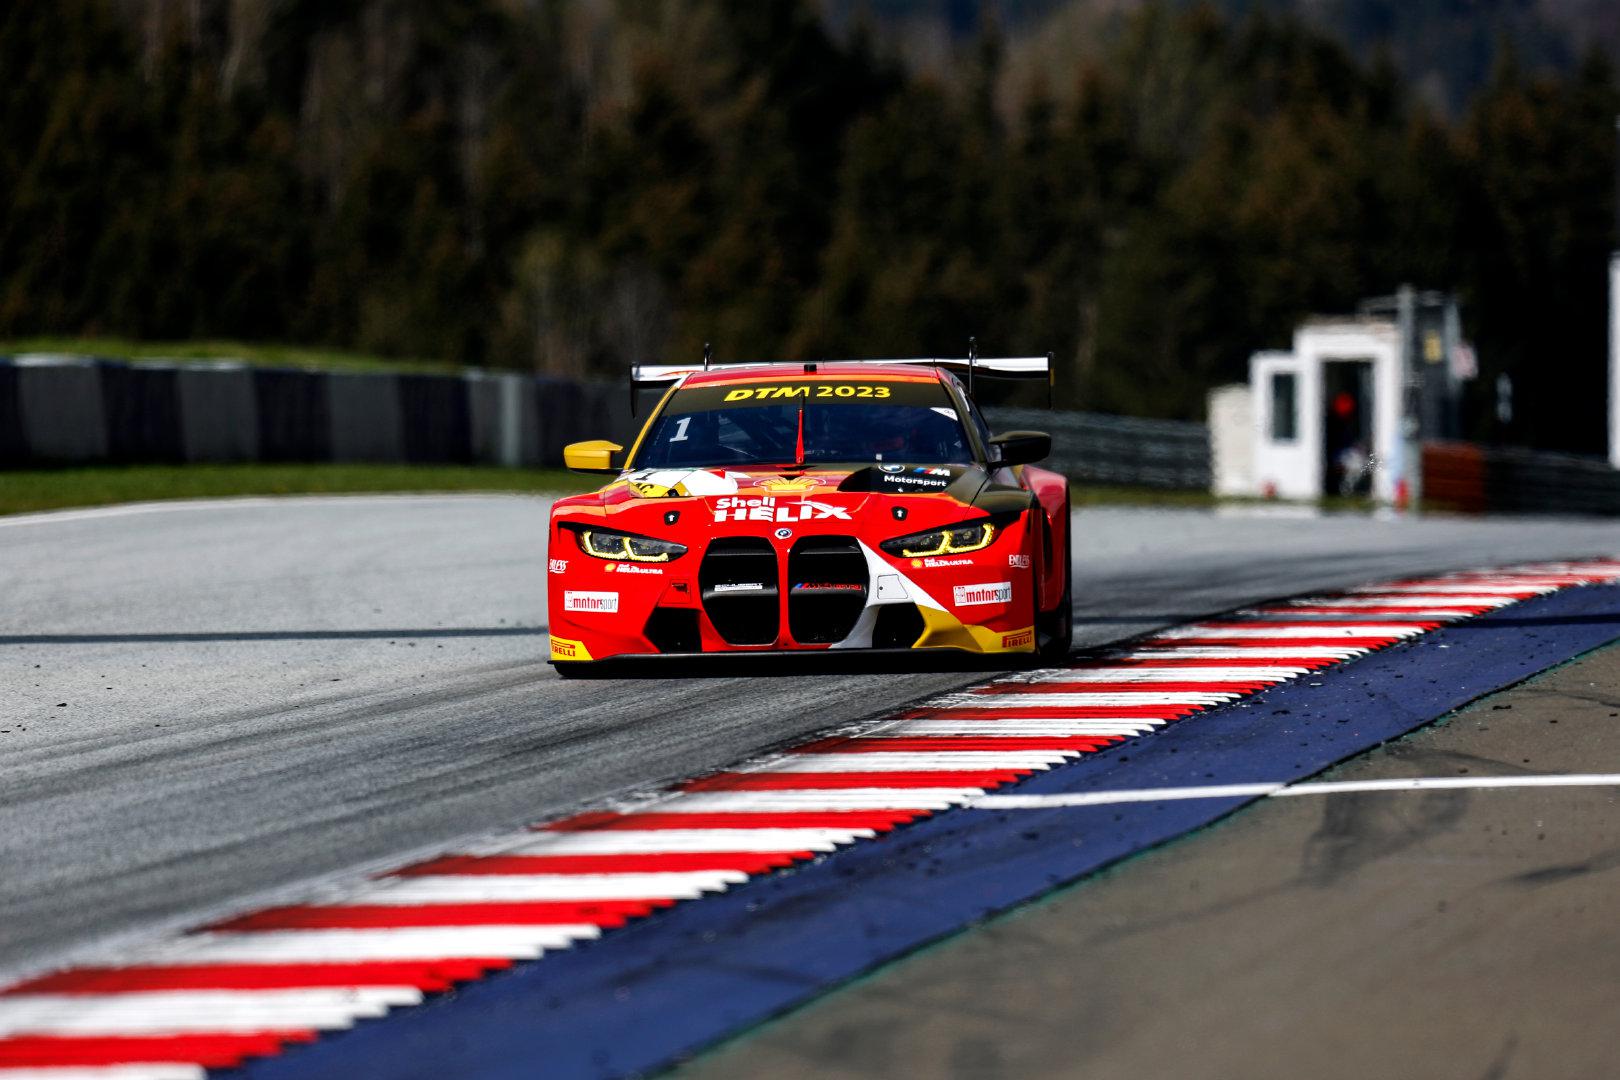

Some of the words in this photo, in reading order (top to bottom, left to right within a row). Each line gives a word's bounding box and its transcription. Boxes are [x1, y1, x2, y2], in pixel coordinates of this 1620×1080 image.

[723, 386, 809, 402] DTM
[816, 385, 891, 399] 2023
[669, 417, 692, 443] 1
[883, 475, 947, 487] Motorsport
[716, 496, 776, 509] Shell
[714, 501, 853, 523] HELIX
[966, 585, 1011, 603] motorsport
[573, 596, 617, 611] motorsport
[1001, 629, 1033, 649] PIRELLI
